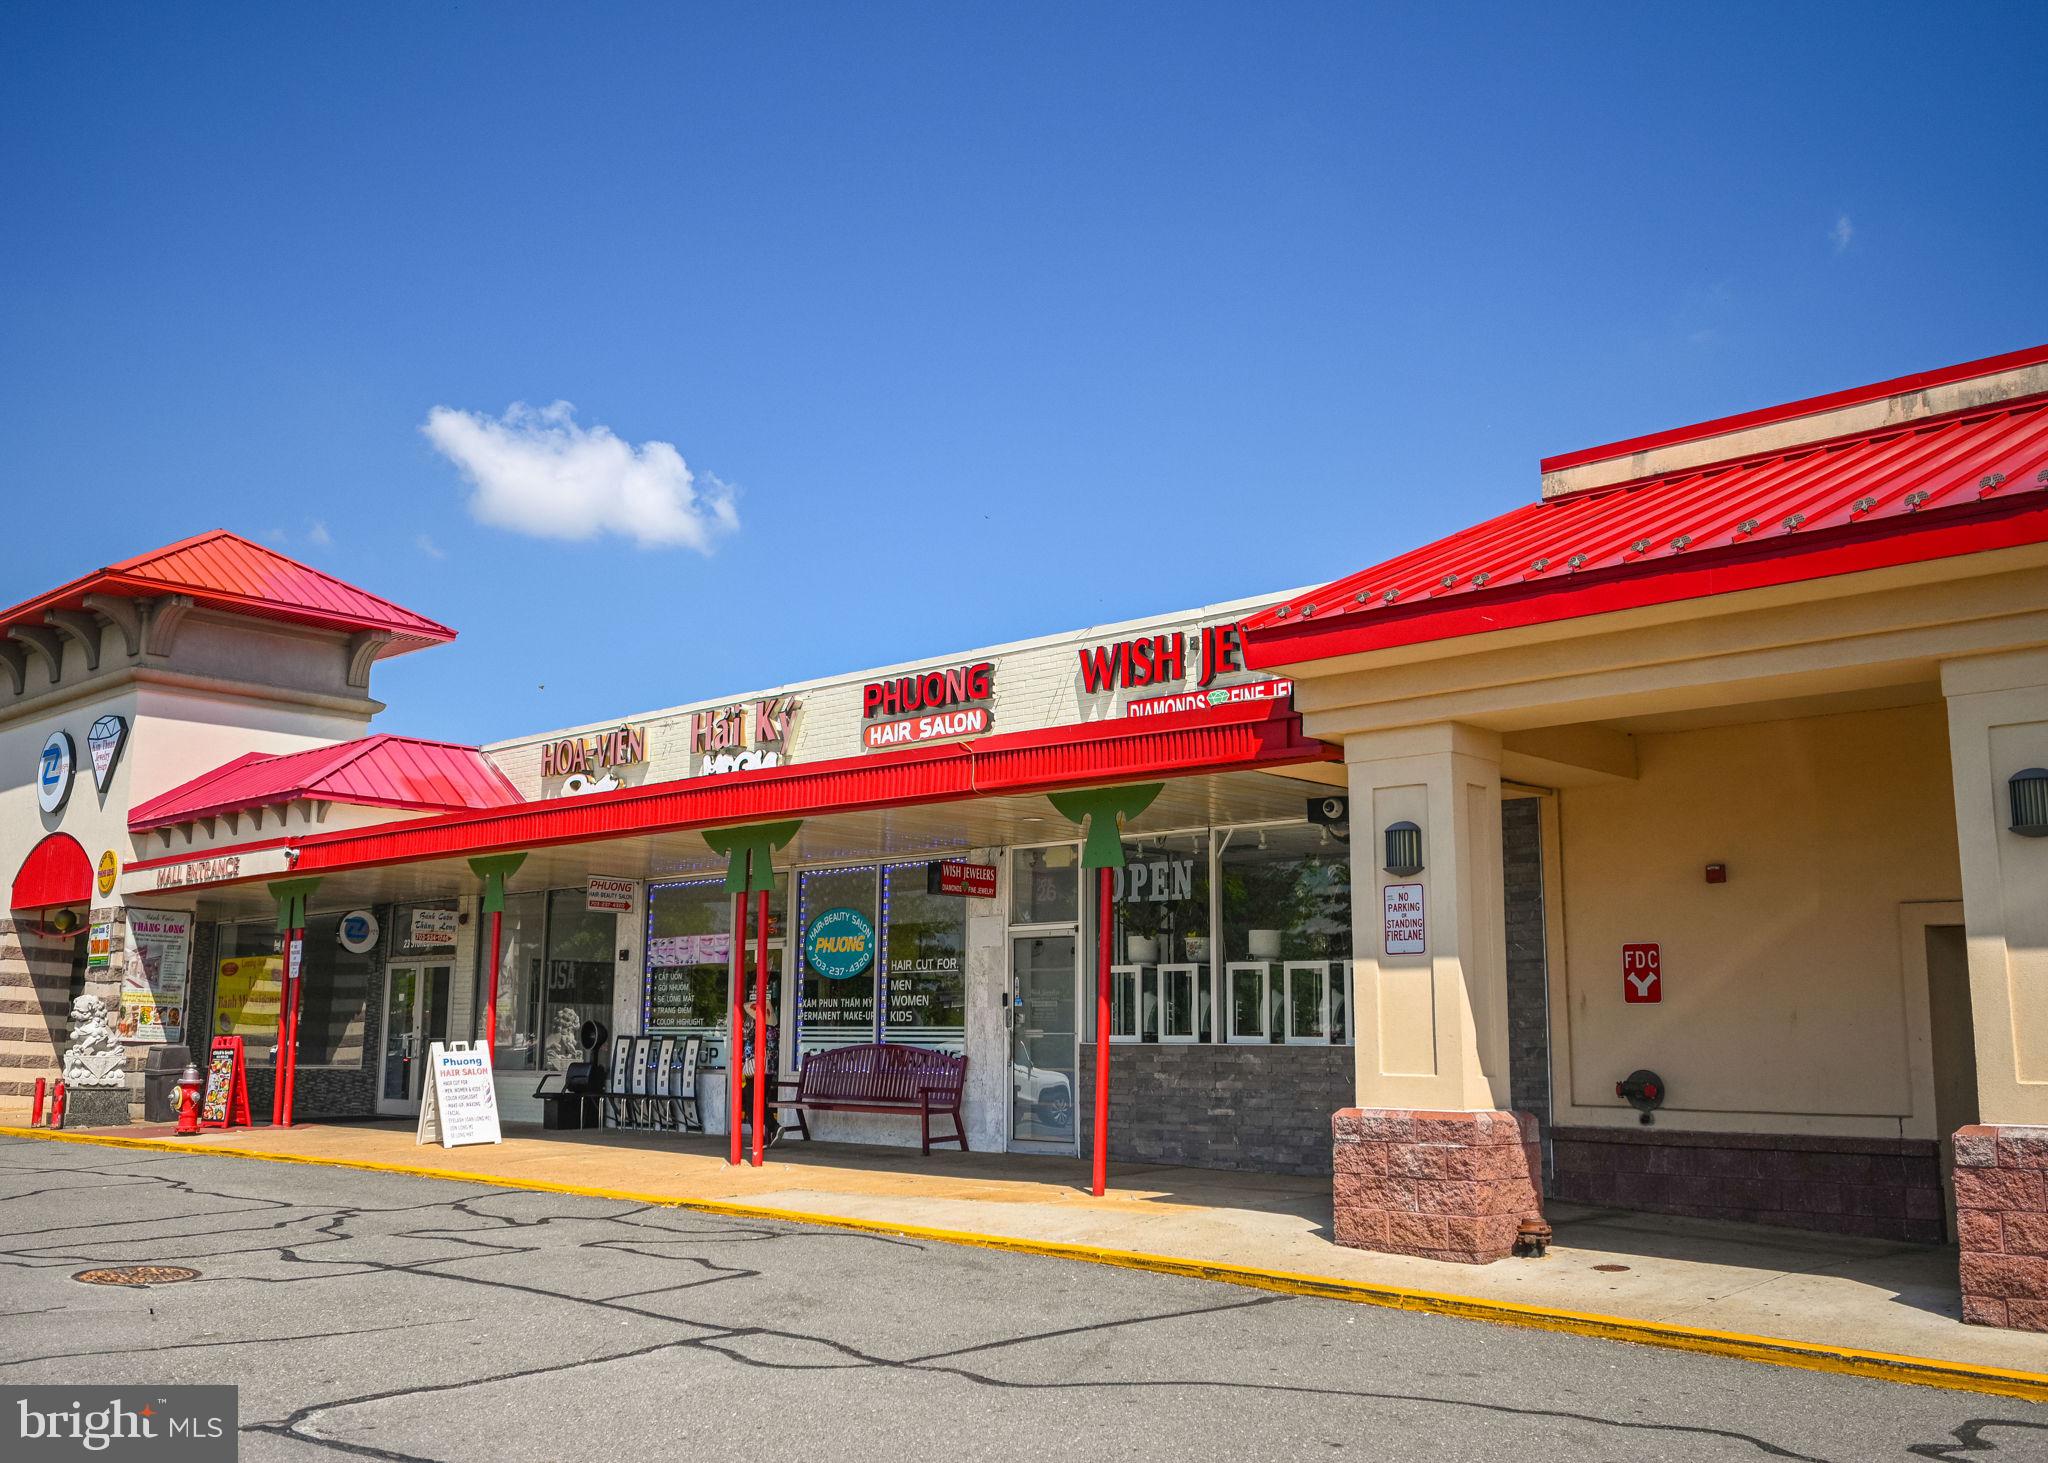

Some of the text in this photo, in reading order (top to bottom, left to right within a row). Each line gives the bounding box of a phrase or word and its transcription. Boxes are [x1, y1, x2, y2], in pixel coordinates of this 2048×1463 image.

[1079, 631, 1185, 694] WISH
[864, 662, 990, 718] PHUONG
[870, 711, 981, 745] HAIR SALON
[157, 857, 240, 887] MALL ENTRANCE
[943, 865, 995, 881] WISH JEWELERS
[590, 880, 632, 892] PHUONG
[1398, 892, 1409, 901] NO
[1388, 903, 1420, 912] PARKING
[163, 922, 185, 934] LONG
[851, 915, 872, 938] SALON
[1387, 919, 1423, 929] STANDING
[815, 935, 866, 953] PHUONG
[891, 960, 912, 970] HAIR
[915, 959, 934, 970] CUT
[1625, 950, 1658, 969] FDC
[891, 980, 911, 990] MEN
[819, 998, 838, 1008] PHUN
[891, 995, 929, 1006] WOMEN
[658, 1006, 676, 1014] TRANG
[799, 1011, 875, 1020] PERMANENT MAKE-UP
[890, 1011, 913, 1022] KIDS
[443, 1058, 482, 1066] Phuong
[440, 1067, 488, 1077] HAIR SALON
